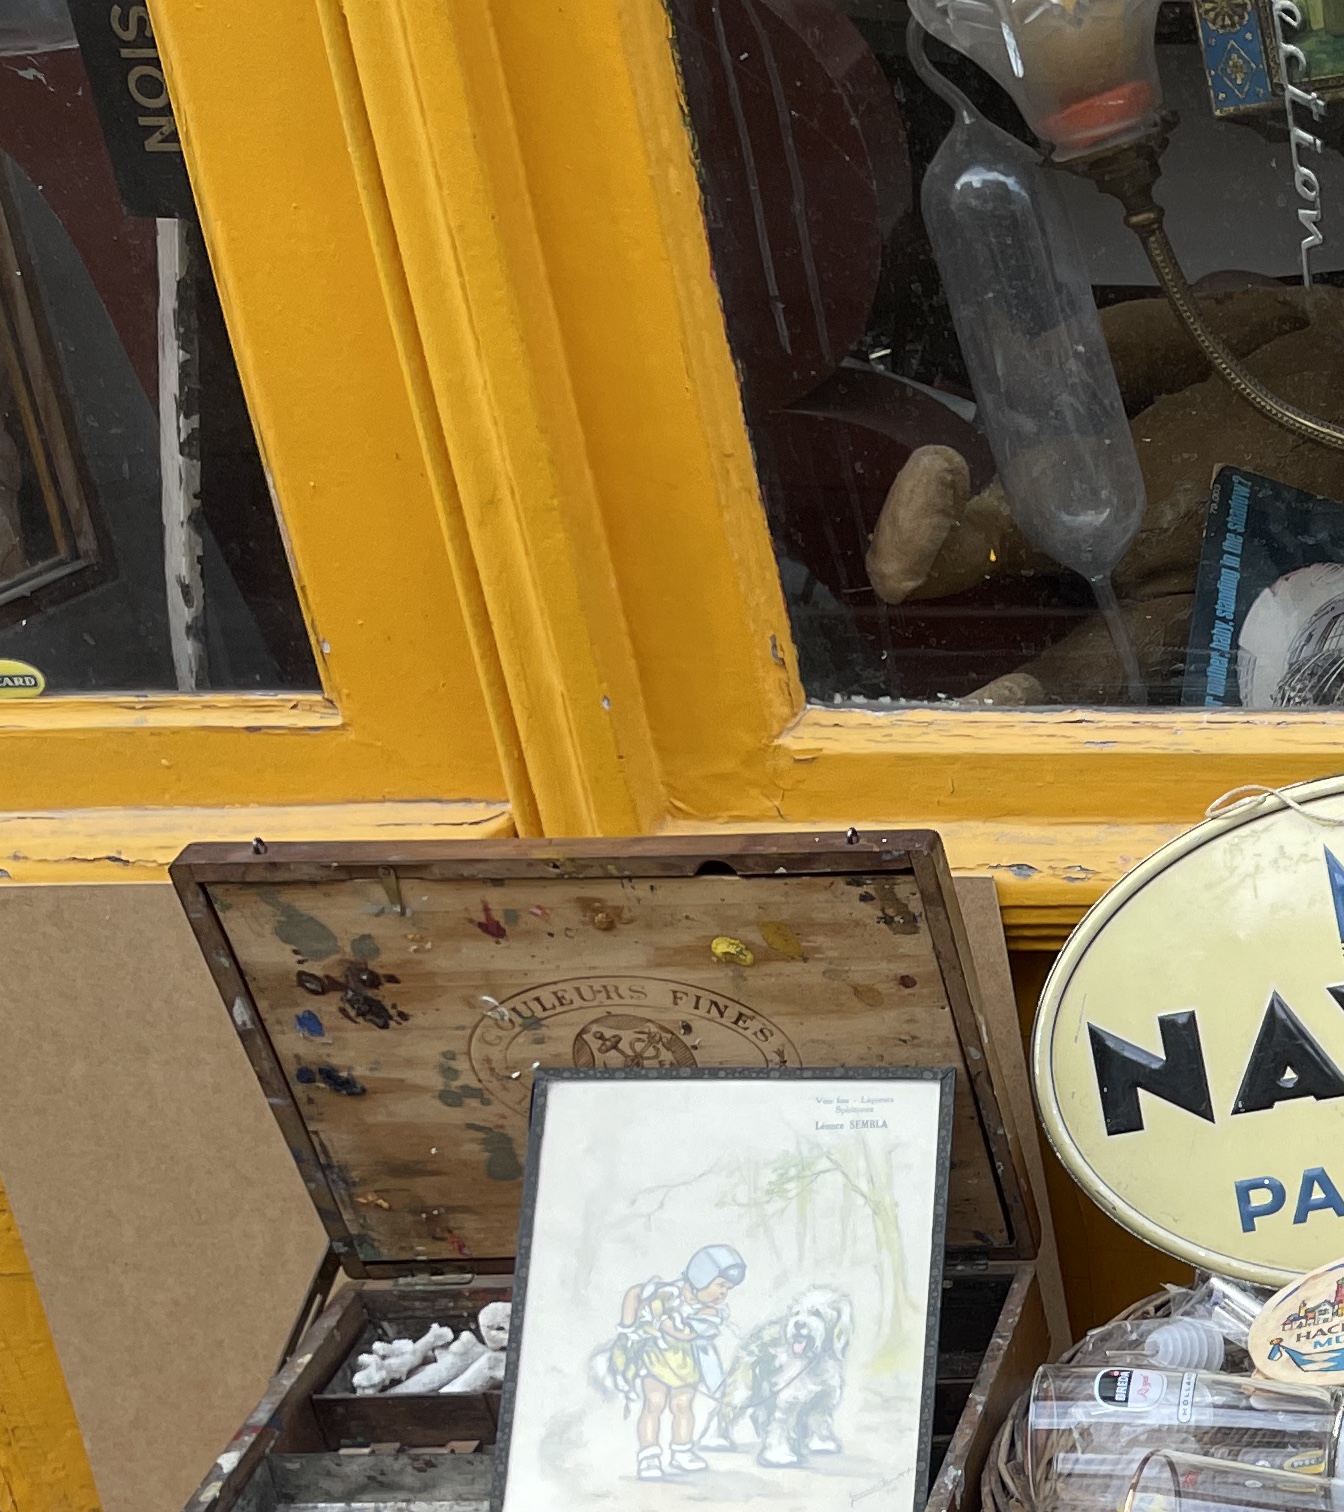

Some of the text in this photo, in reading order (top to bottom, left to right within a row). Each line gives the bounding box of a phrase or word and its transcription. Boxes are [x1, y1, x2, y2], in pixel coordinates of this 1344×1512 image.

[1225, 474, 1252, 533] shadow?
[1222, 533, 1244, 555] the
[1220, 554, 1240, 568] in
[1215, 567, 1241, 620] standing
[1209, 620, 1234, 652] baby,
[0, 676, 36, 687] ARD
[669, 988, 776, 1045] FINES
[1115, 1371, 1131, 1401] BREDA
